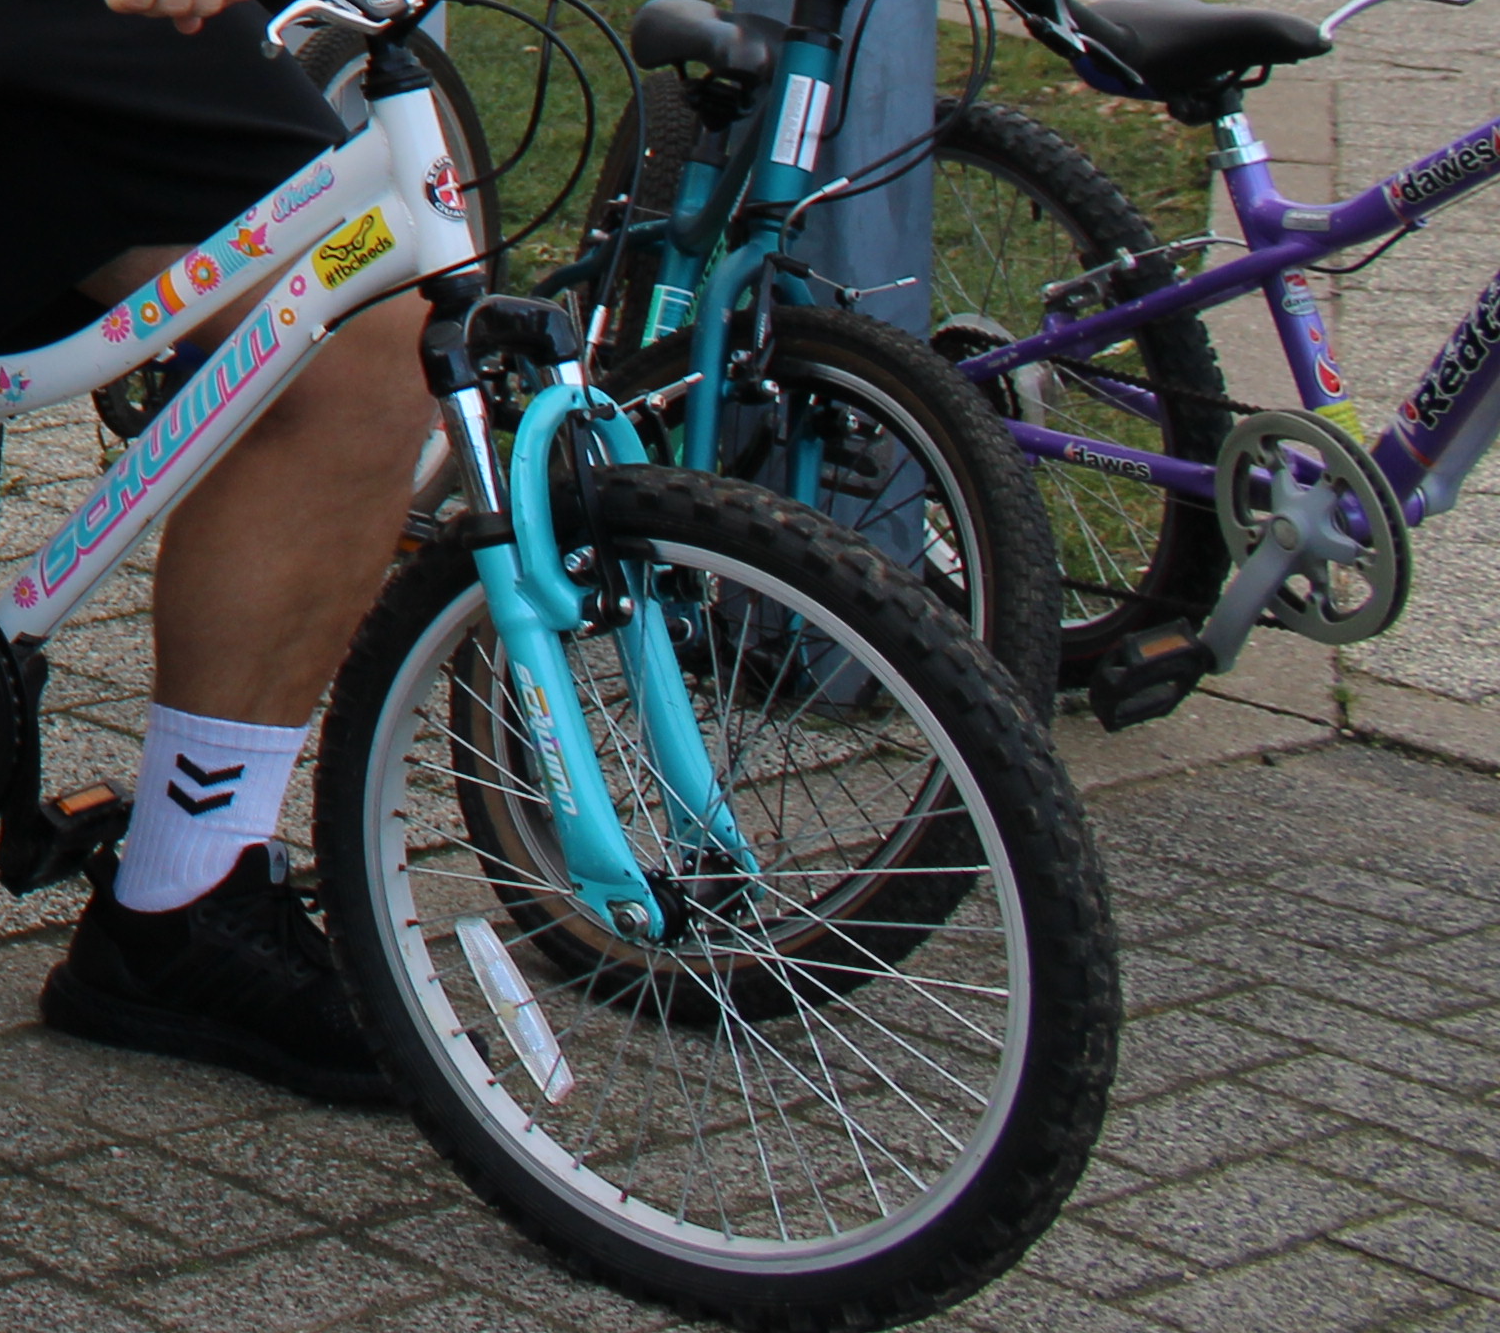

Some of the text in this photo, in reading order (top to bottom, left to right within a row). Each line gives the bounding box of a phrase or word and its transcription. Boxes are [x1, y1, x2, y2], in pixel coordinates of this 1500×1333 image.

[1401, 138, 1497, 204] dawes
[324, 235, 393, 287] #tbcleeds
[1073, 444, 1152, 481] dawes
